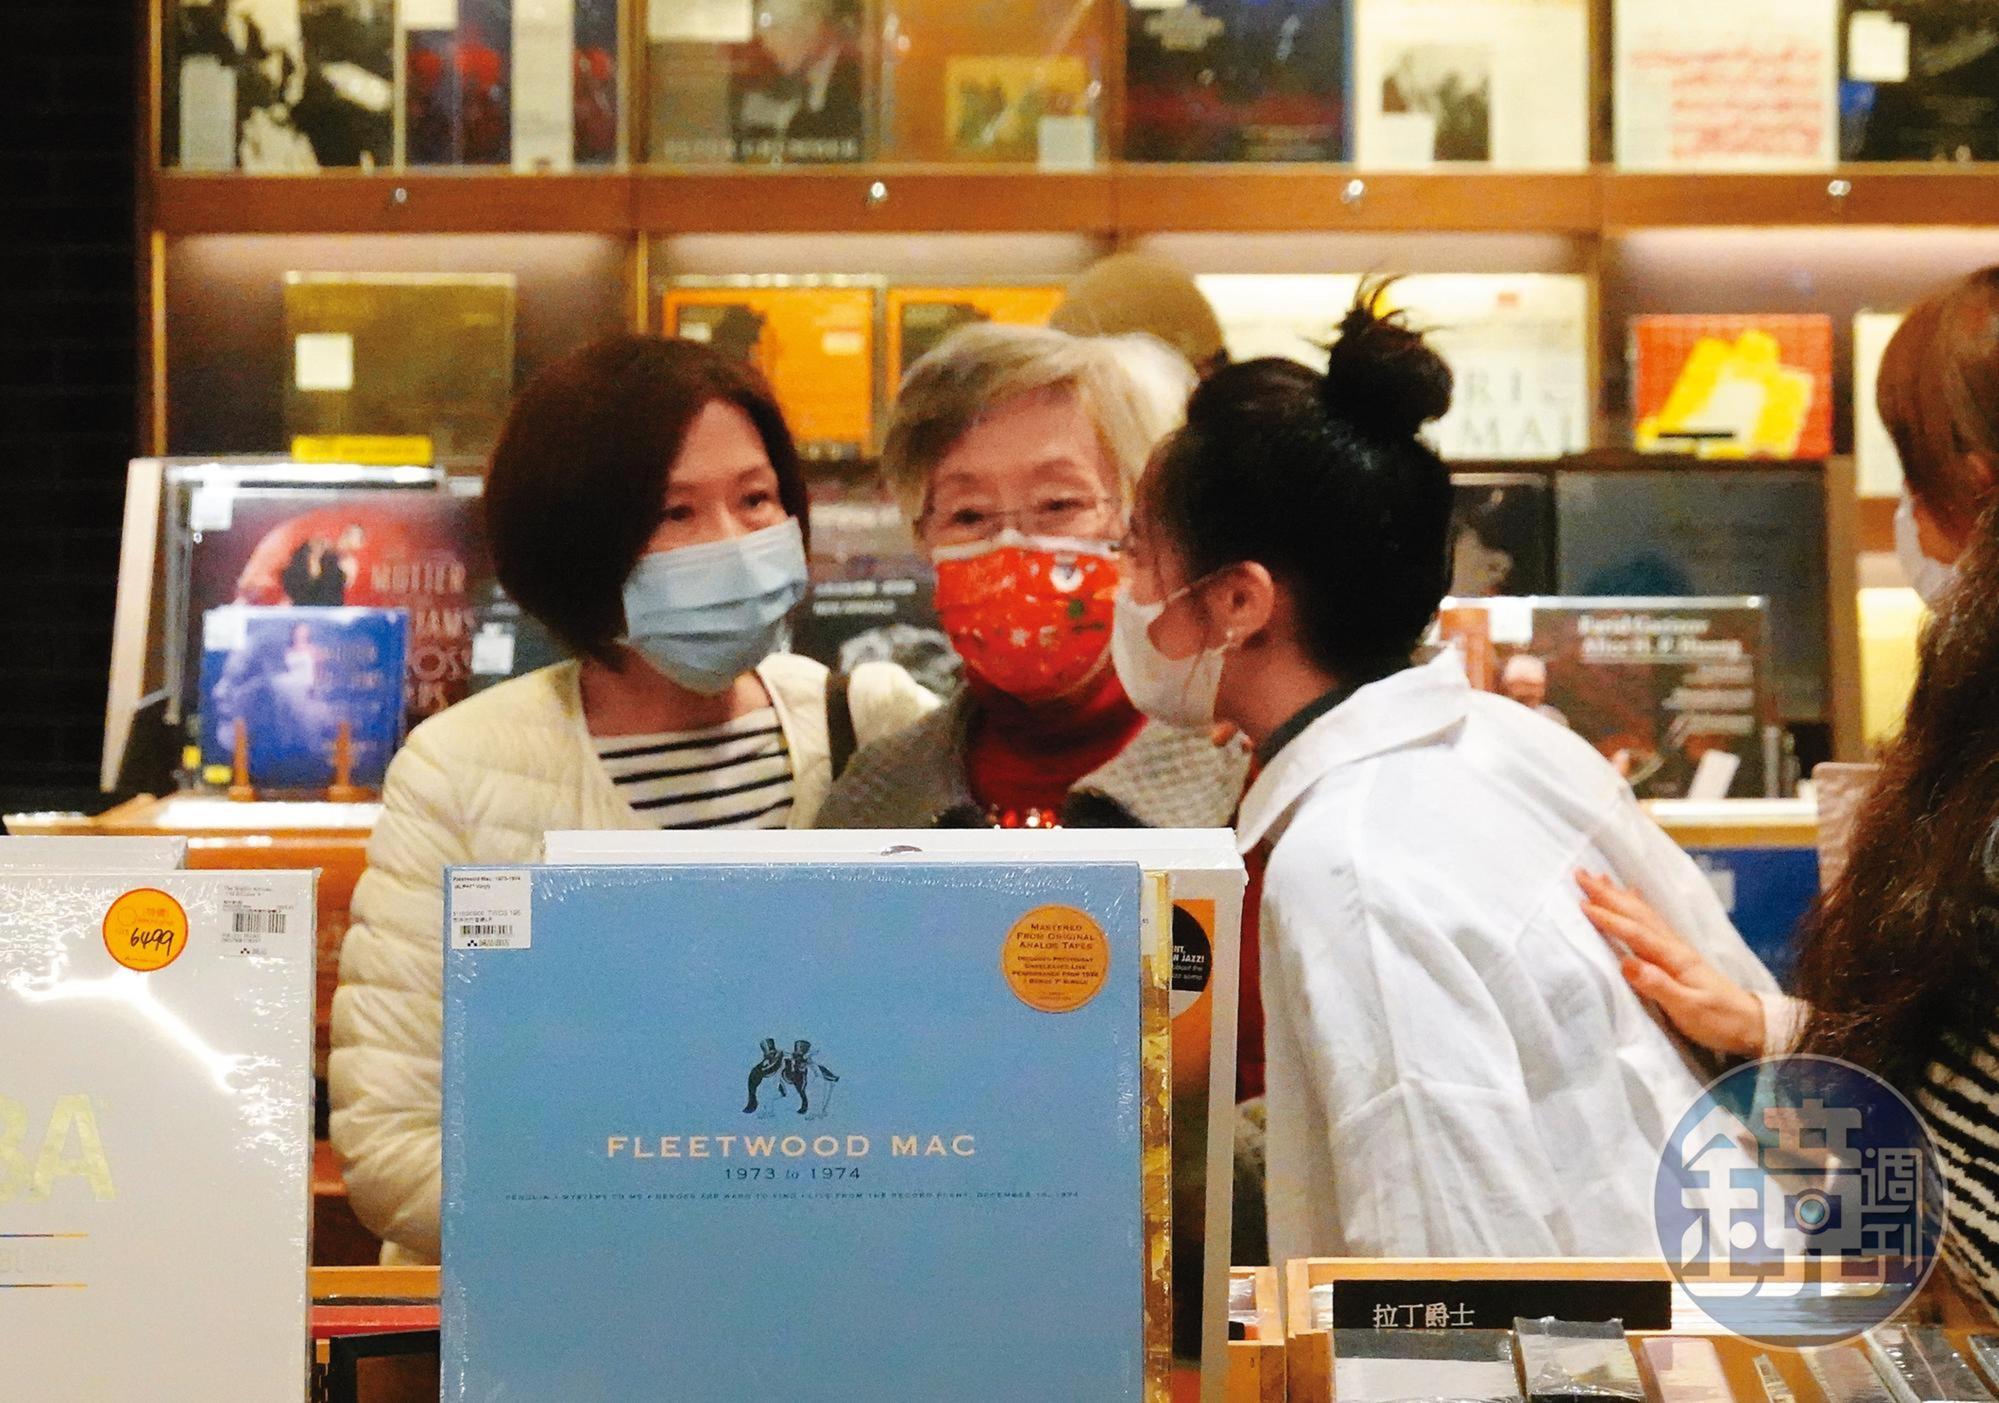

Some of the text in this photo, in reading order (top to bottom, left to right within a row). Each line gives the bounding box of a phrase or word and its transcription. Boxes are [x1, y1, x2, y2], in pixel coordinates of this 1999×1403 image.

[130, 927, 174, 957] 6499
[1016, 932, 1095, 941] FROM ORIGINAL
[1061, 941, 1093, 950] TAPES
[1181, 954, 1205, 963] JAZZ!
[606, 1134, 976, 1158] FLEETWOOD MAC
[724, 1166, 861, 1181] 1973 to 1974
[1372, 1302, 1475, 1329] 拉丁爵士
